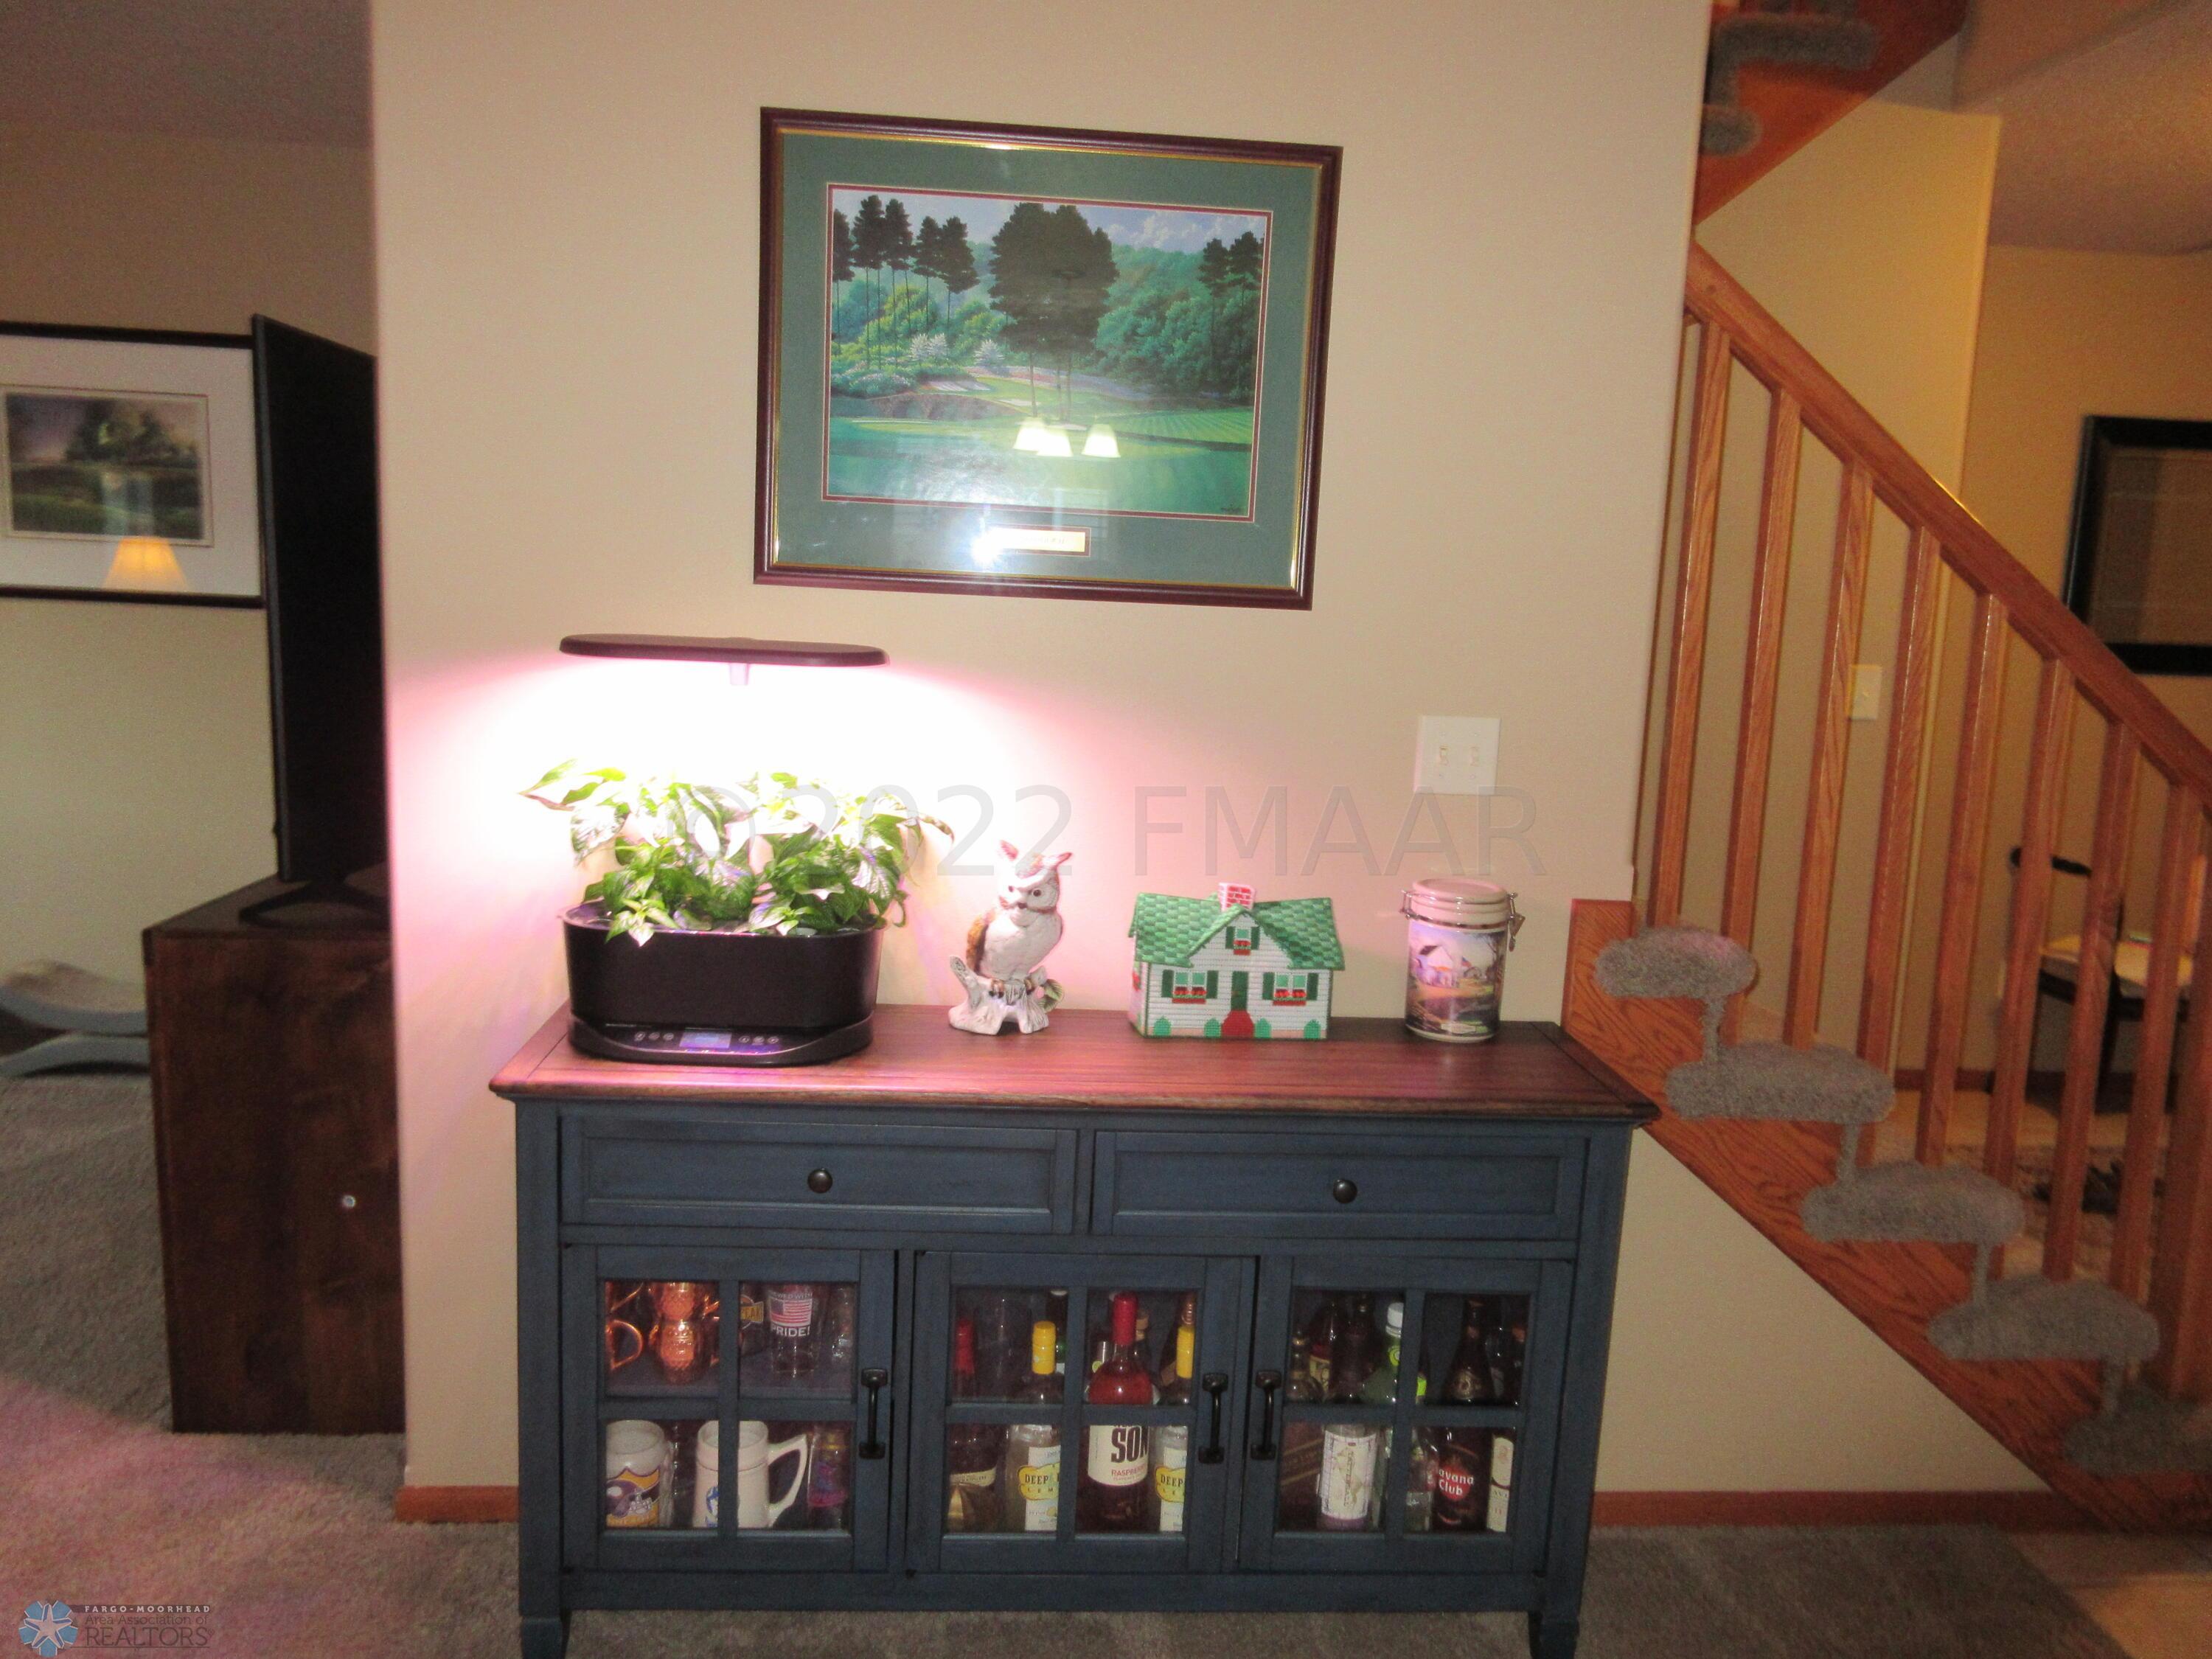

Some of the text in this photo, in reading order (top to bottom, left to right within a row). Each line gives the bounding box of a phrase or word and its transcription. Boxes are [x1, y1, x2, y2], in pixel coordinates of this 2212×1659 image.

[1024, 1473, 1049, 1485] DEEP
[1161, 1474, 1184, 1487] DEEP
[1439, 1479, 1464, 1496] Club
